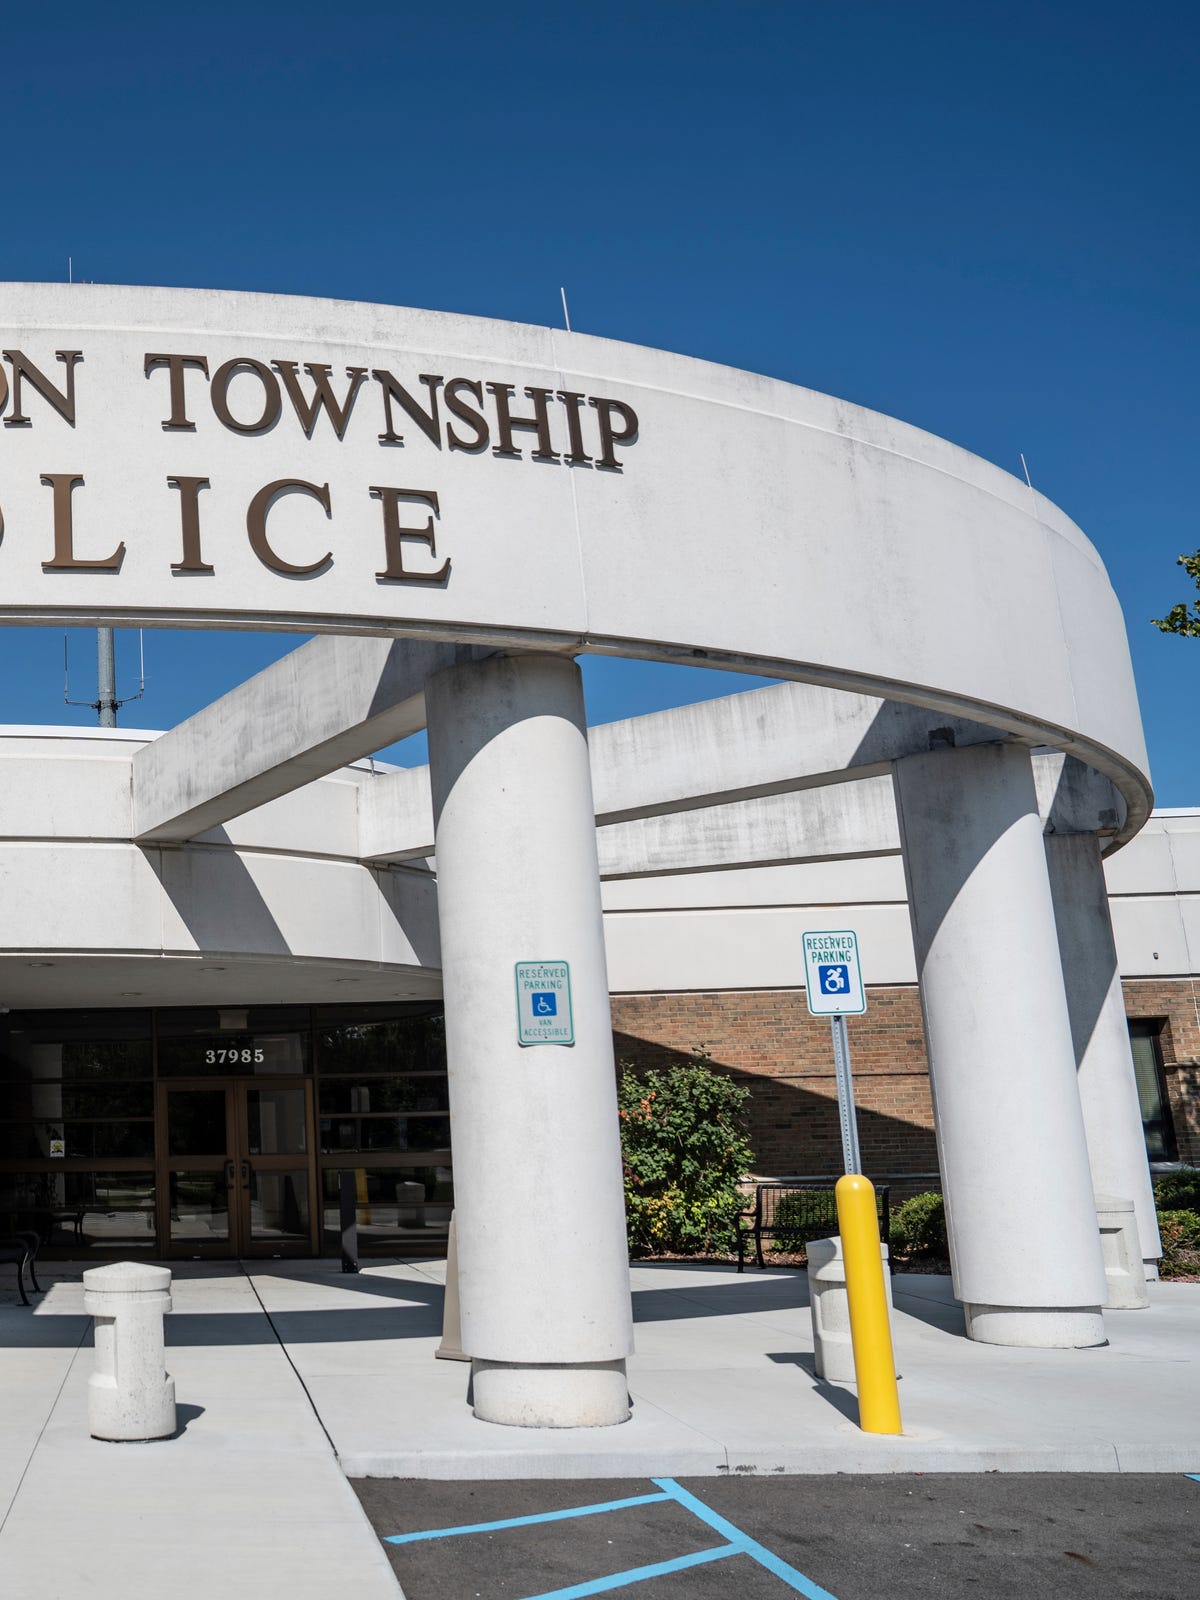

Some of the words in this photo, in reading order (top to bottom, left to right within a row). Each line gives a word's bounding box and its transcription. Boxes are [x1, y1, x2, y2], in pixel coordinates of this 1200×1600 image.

[144, 352, 638, 467] TOWNSHIP
[806, 937, 853, 950] RESERVED
[812, 951, 852, 963] PARKING
[519, 968, 567, 978] RESERVED
[524, 980, 562, 990] PARKING
[524, 1028, 568, 1037] ACCESSIBLE
[206, 1049, 264, 1063] 37985
